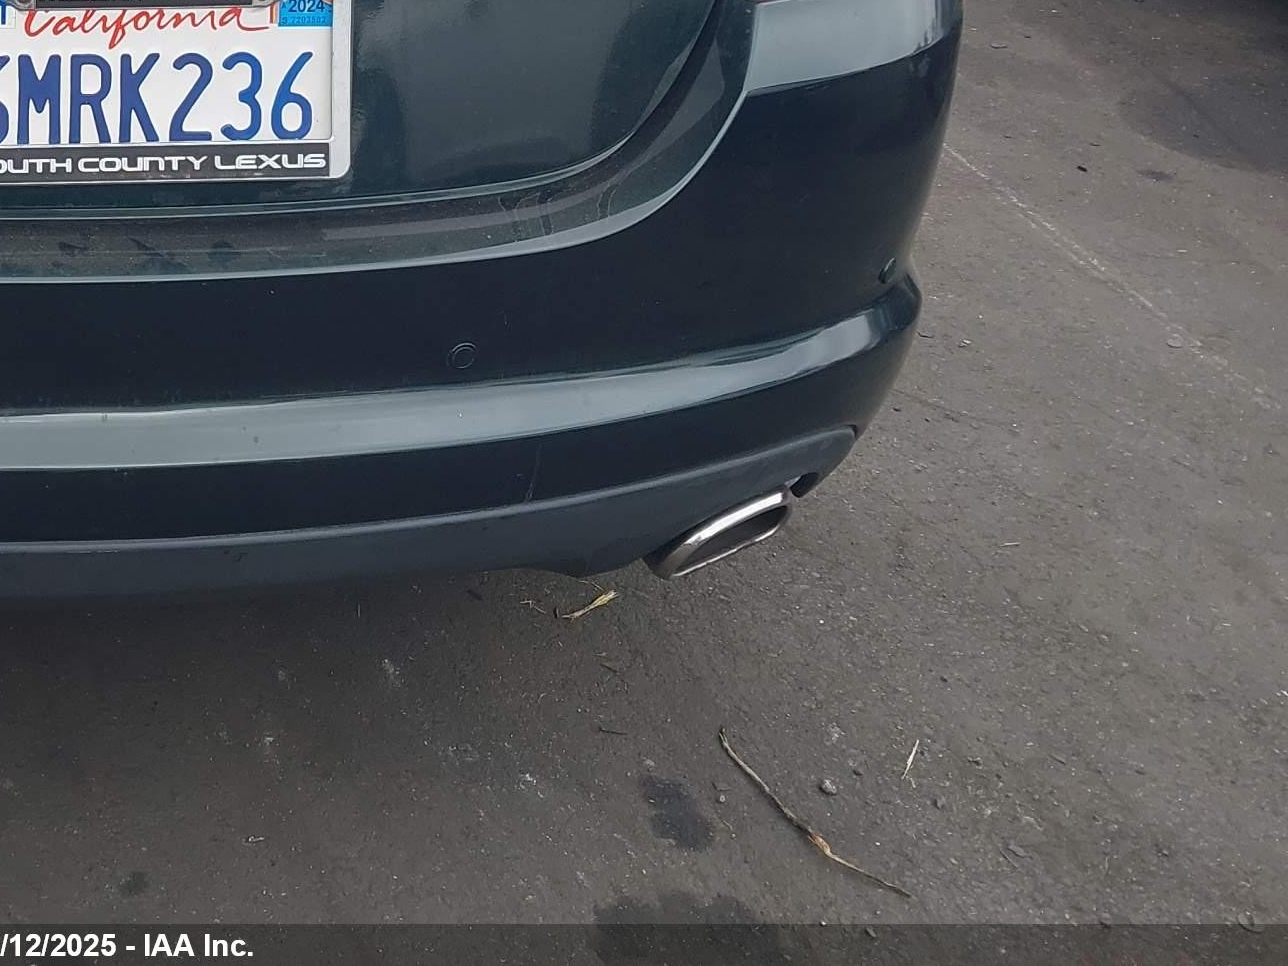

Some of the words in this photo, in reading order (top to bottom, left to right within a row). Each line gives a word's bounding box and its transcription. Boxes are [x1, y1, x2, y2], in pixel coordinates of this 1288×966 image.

[24, 7, 269, 49] California
[77, 155, 208, 173] COUNTY
[214, 153, 326, 170] LEXUS
